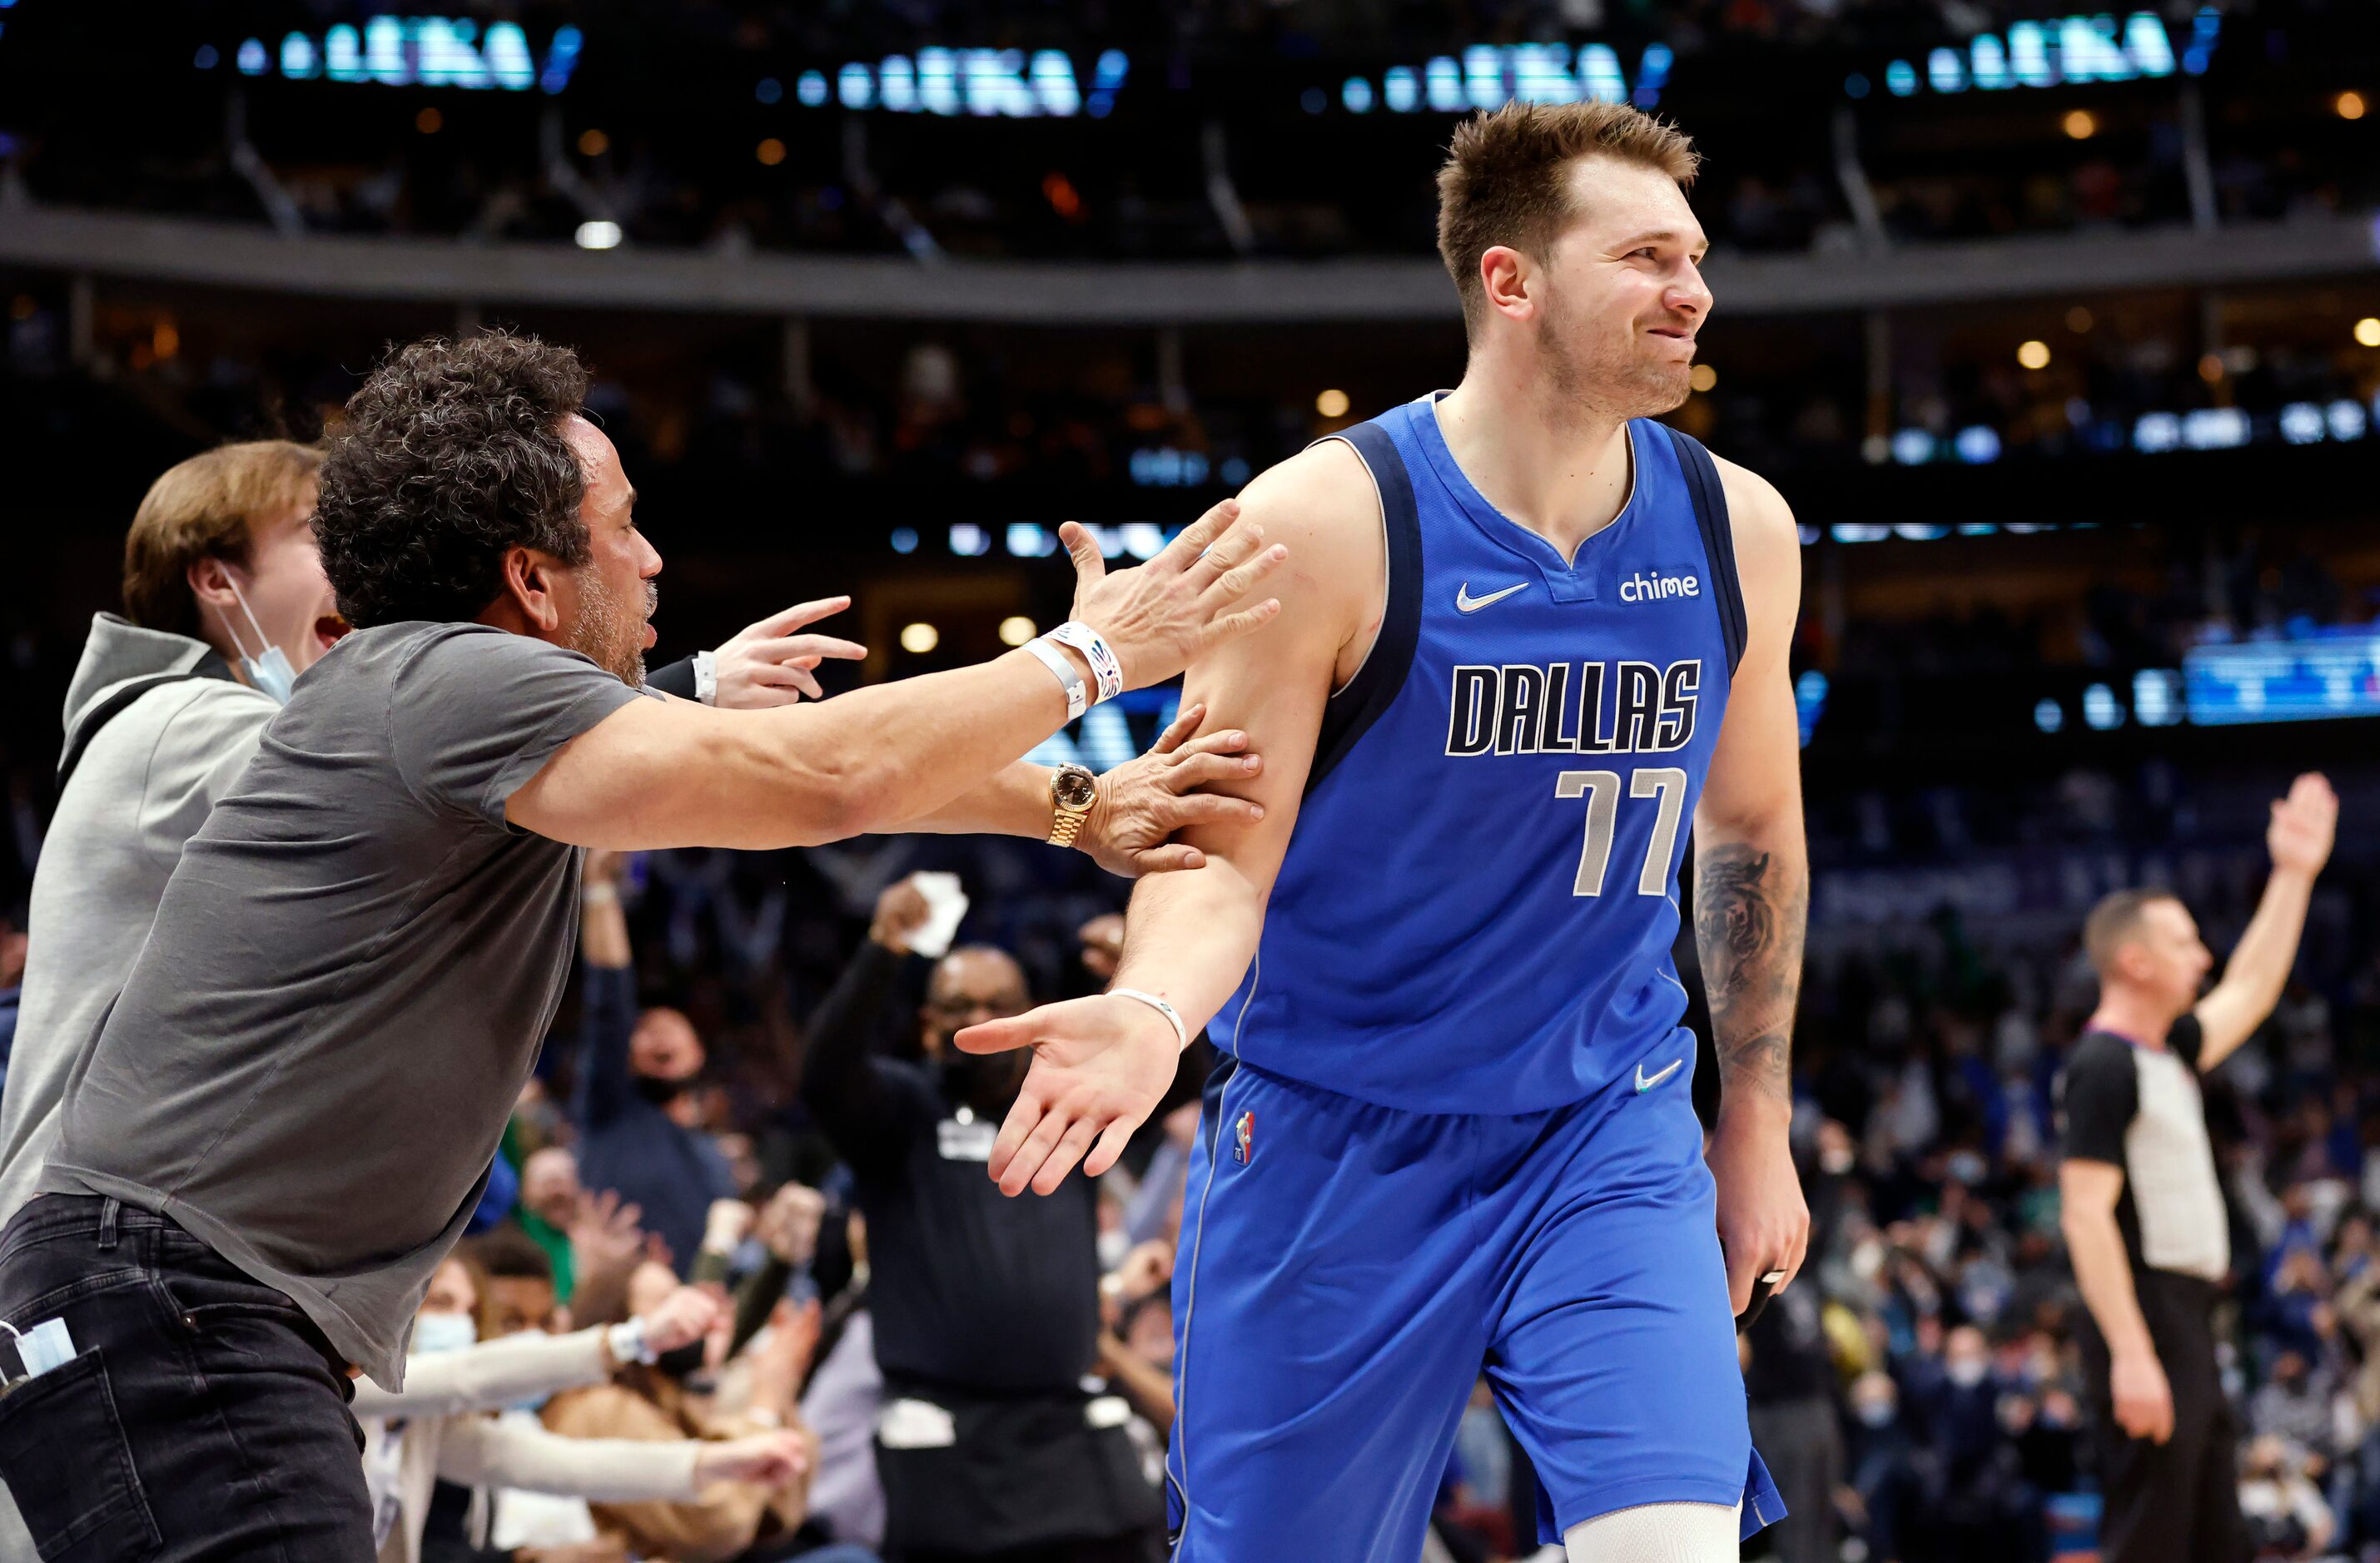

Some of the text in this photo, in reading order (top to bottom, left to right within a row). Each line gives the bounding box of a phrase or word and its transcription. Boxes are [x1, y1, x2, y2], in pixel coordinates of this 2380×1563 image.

[1620, 571, 1699, 602] chime
[1445, 659, 1702, 757] DALLAS
[1554, 768, 1687, 897] 77
